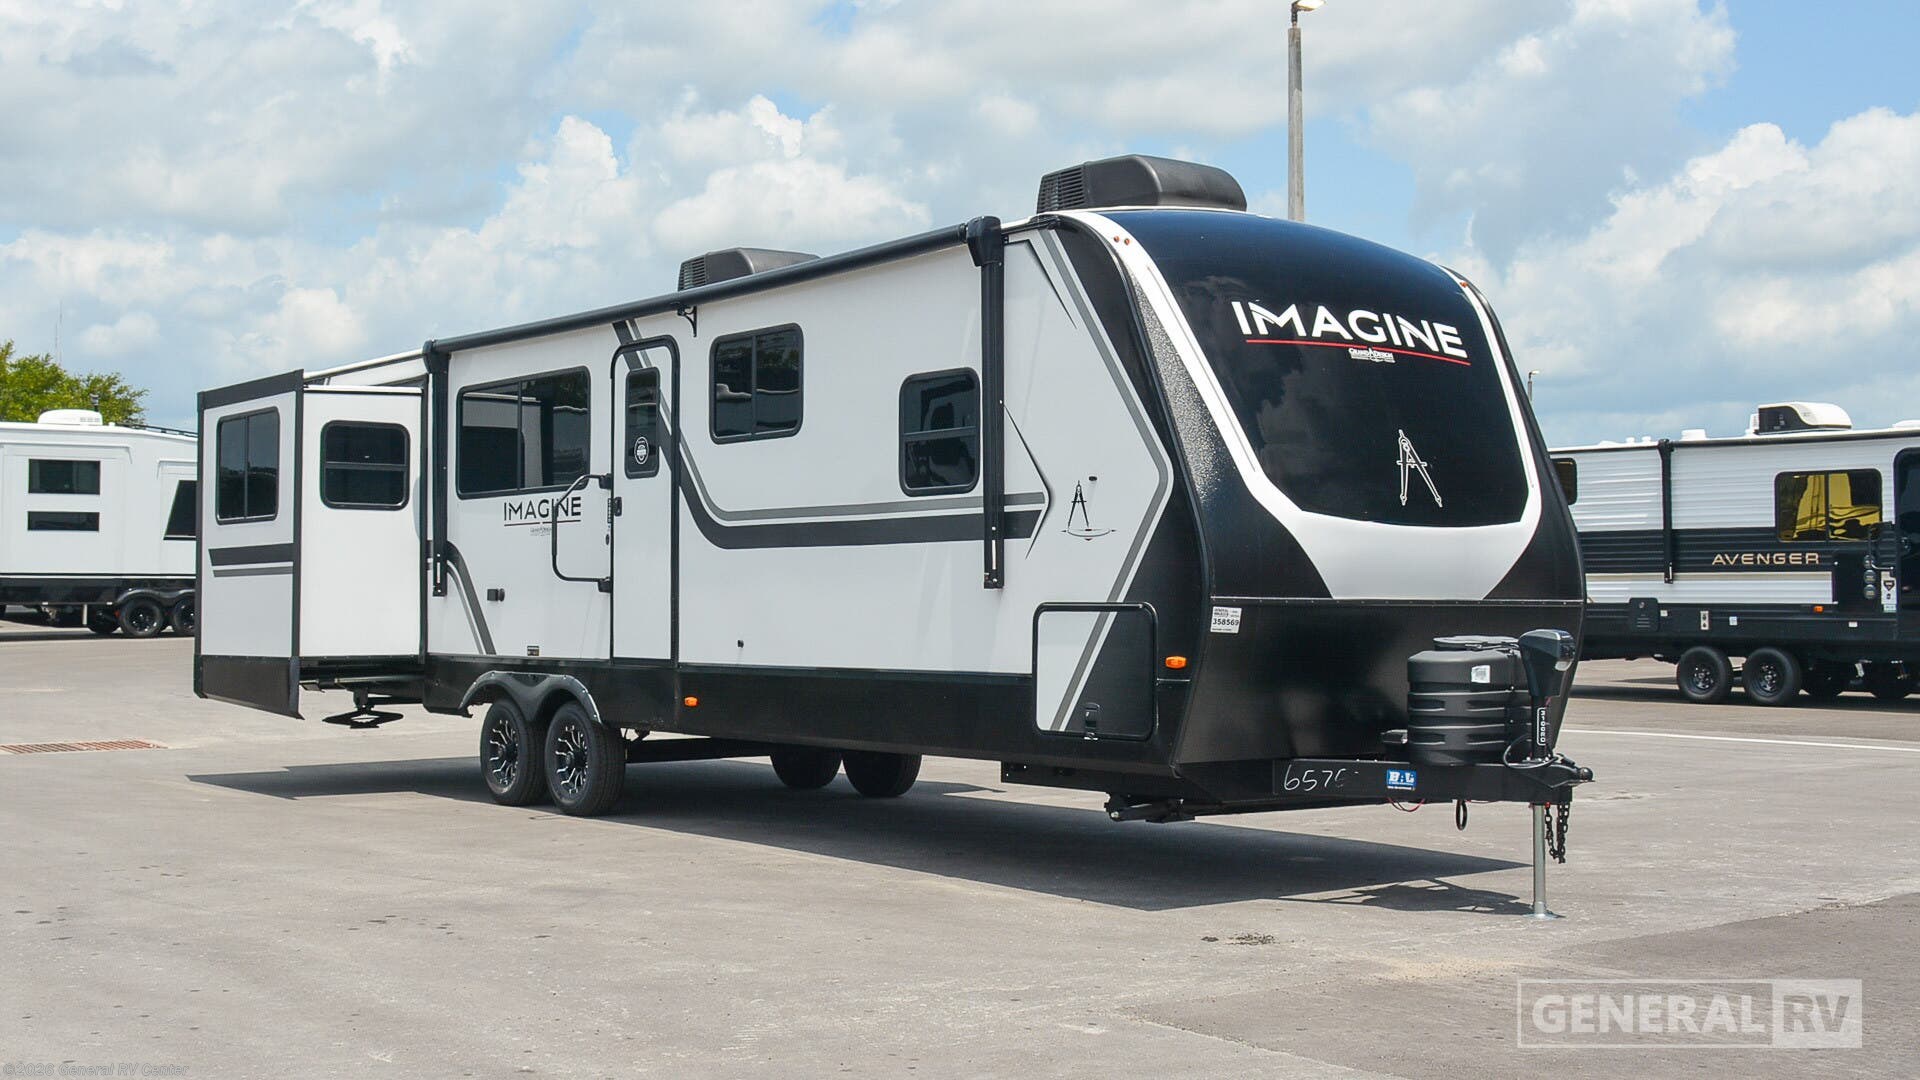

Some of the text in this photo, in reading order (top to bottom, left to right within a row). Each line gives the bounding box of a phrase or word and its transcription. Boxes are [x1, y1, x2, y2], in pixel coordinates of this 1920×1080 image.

[1231, 301, 1468, 358] IMAGINE
[1711, 552, 1820, 566] AVENGER
[1212, 618, 1240, 626] 358569
